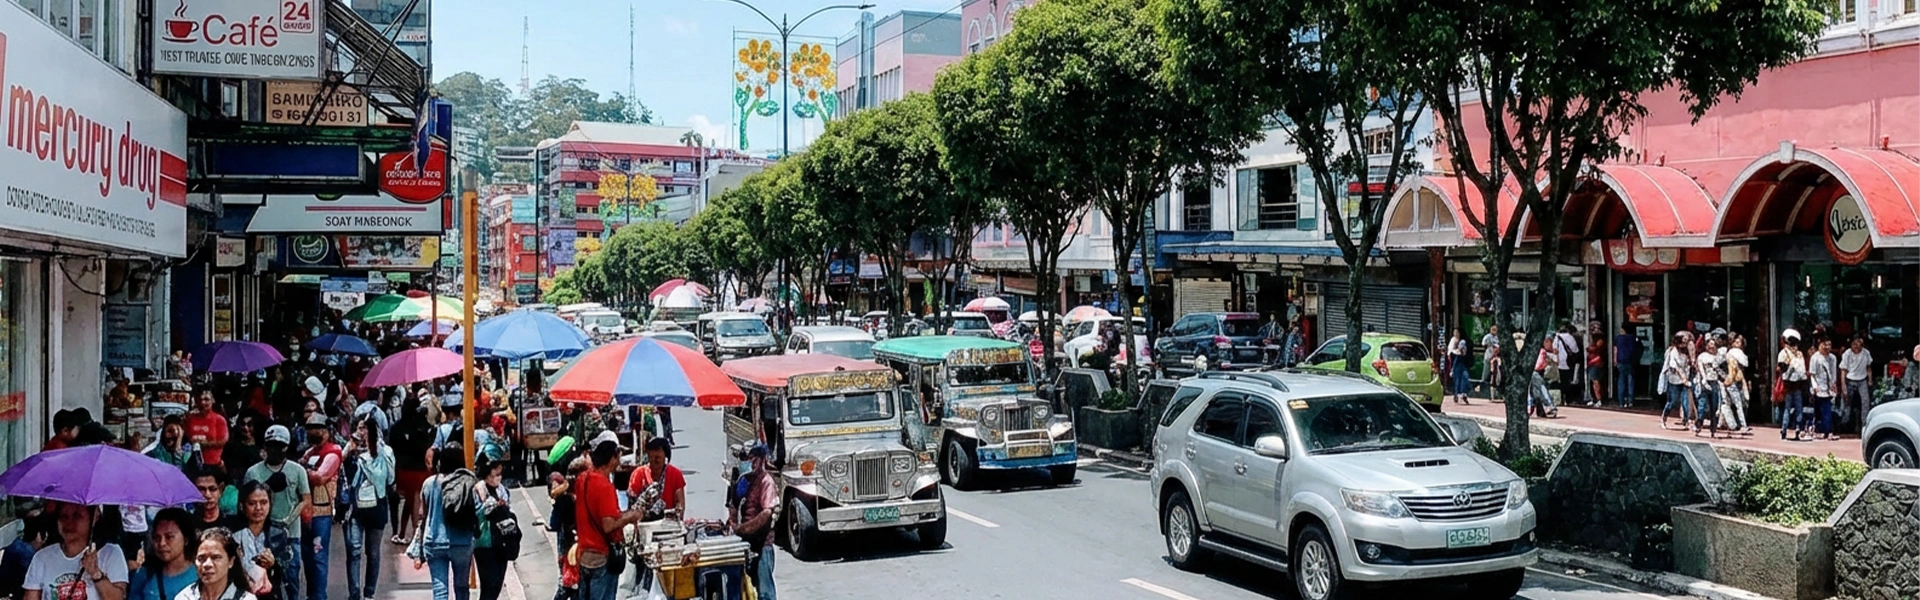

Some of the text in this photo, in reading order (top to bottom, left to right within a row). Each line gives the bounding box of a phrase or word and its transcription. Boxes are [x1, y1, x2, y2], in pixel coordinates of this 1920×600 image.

[284, 1, 310, 20] 24
[202, 14, 278, 47] Café
[7, 84, 157, 211] mercury drug
